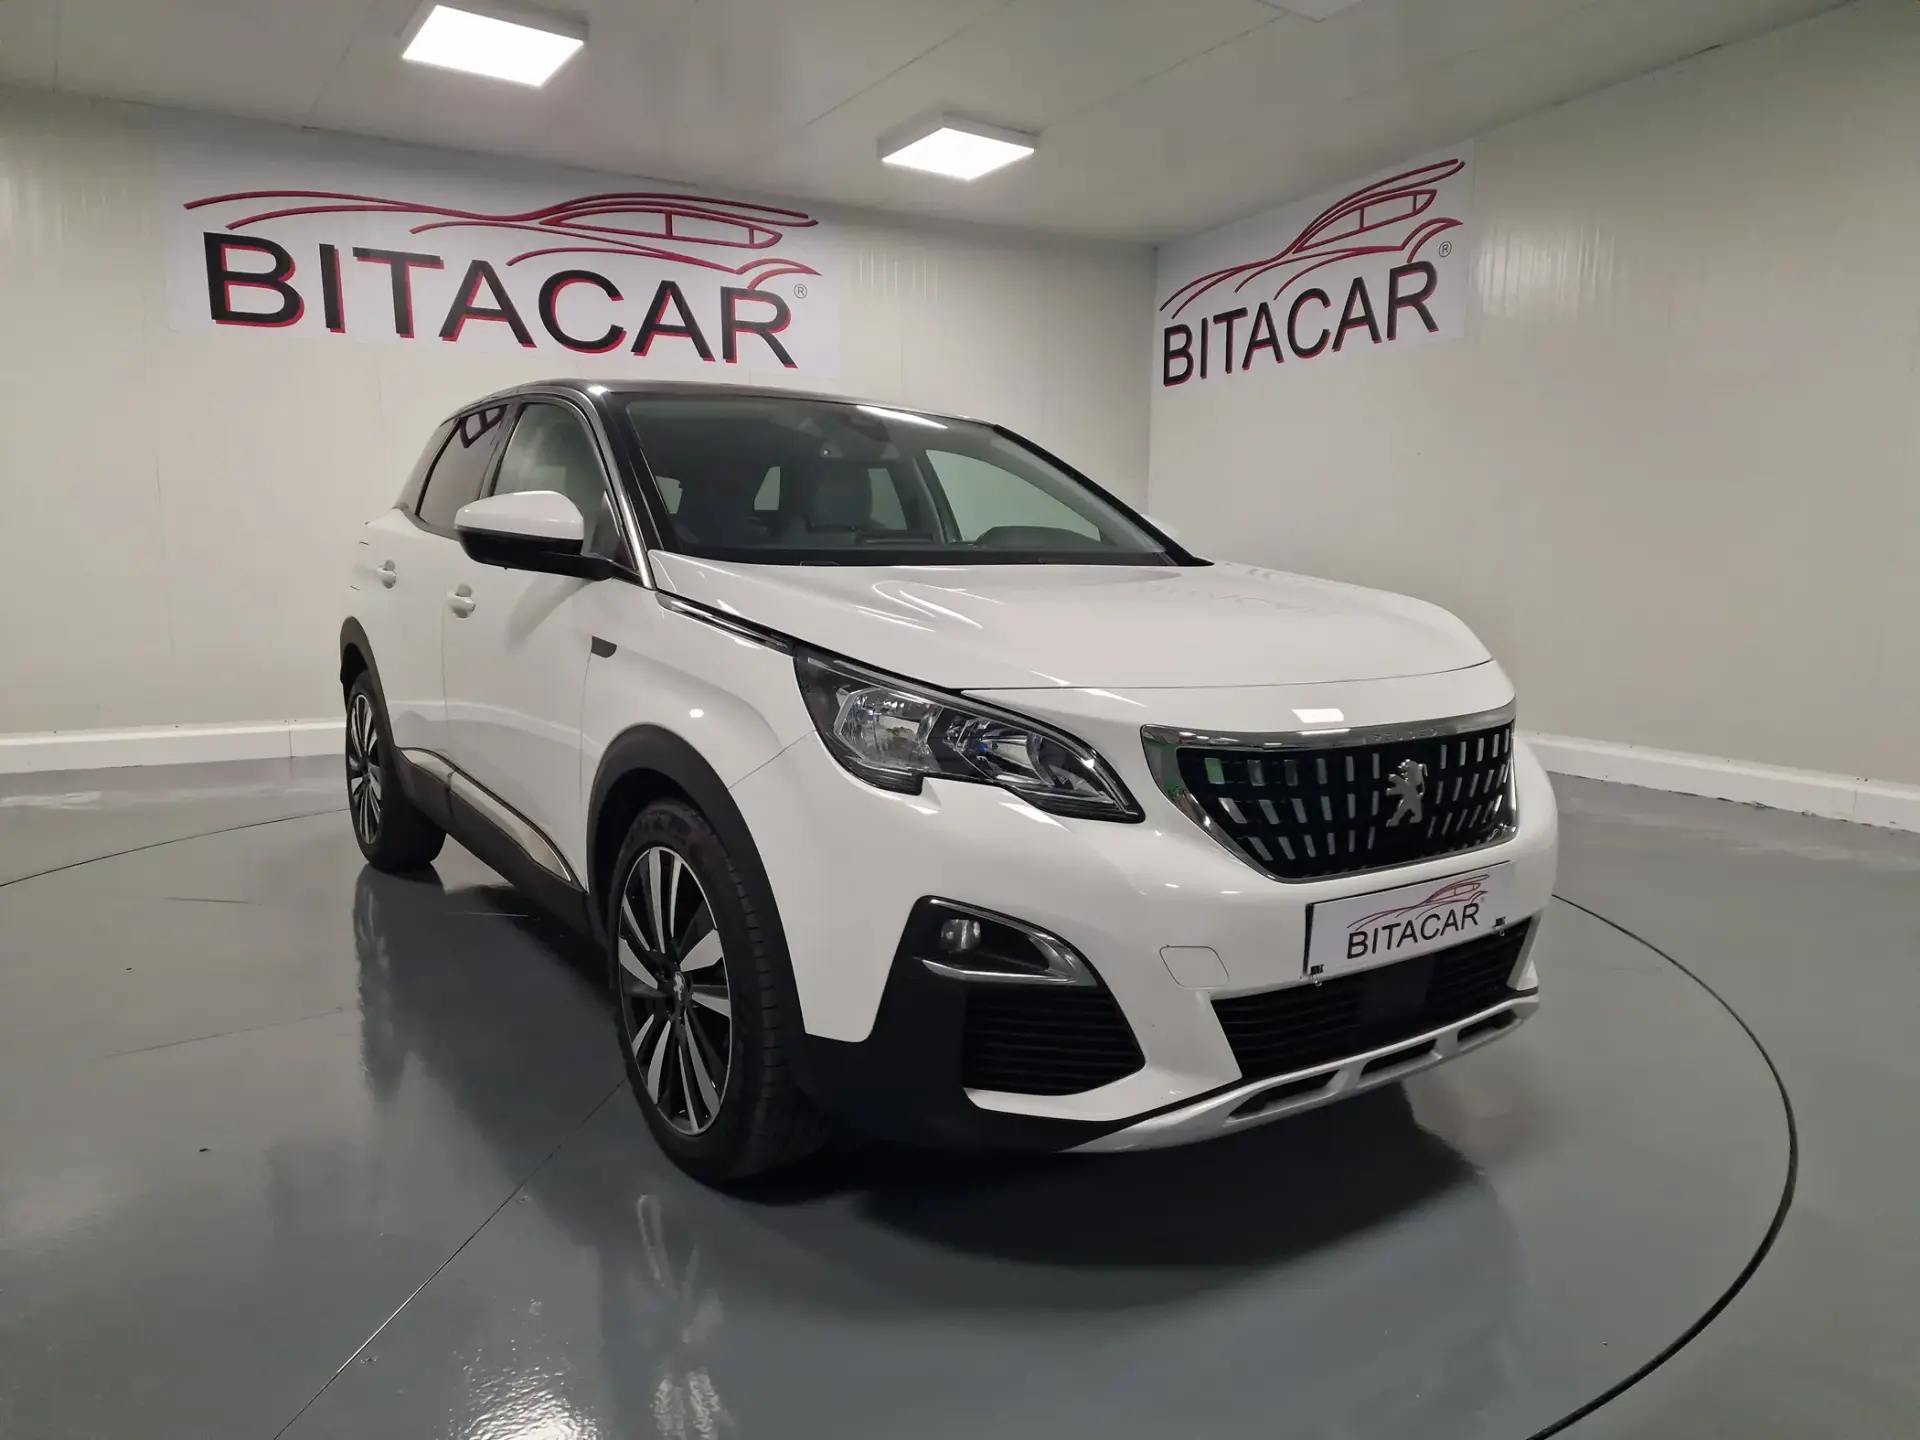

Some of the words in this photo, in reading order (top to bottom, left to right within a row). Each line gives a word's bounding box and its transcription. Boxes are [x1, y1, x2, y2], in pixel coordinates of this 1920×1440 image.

[203, 231, 798, 369] BITACAR
[1162, 261, 1439, 387] BITACAR
[1346, 902, 1480, 960] BITACAR
